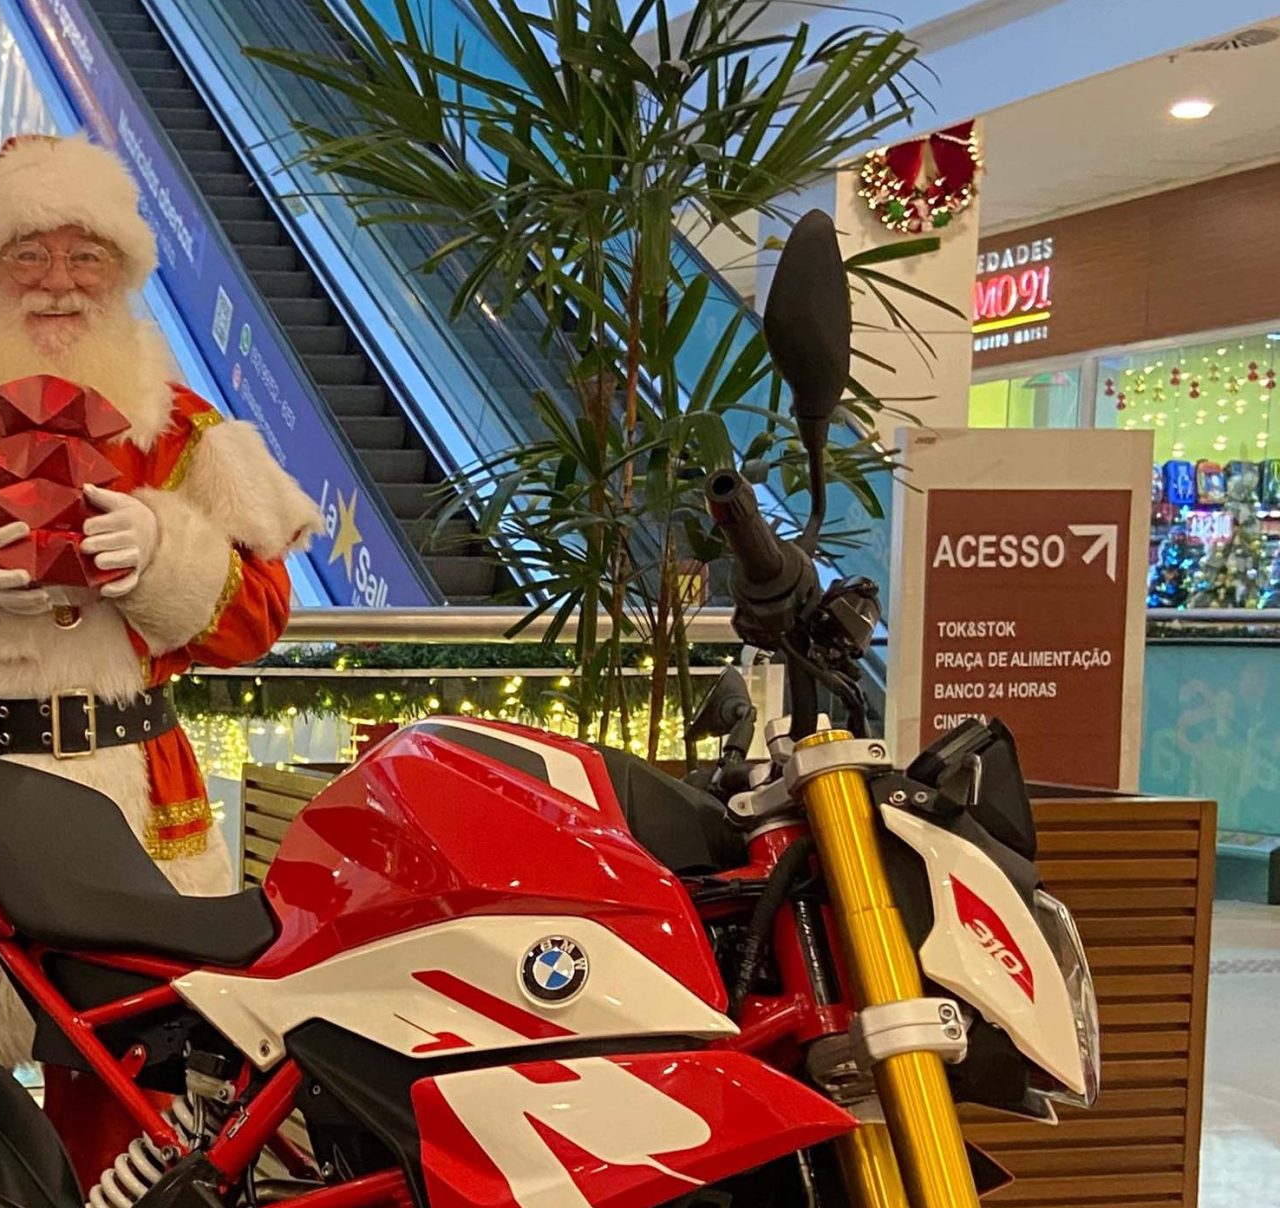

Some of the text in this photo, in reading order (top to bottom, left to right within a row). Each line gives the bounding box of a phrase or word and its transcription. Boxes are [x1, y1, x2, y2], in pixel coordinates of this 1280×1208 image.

[932, 534, 1066, 569] ACESSO
[355, 545, 391, 607] Sall
[937, 621, 1017, 638] TOK&STOK
[935, 648, 1112, 671] PRAÇA DE ALIMENTAÇÃO
[934, 682, 1057, 699] BANCO 24 HORAS
[964, 918, 1024, 976] 310
